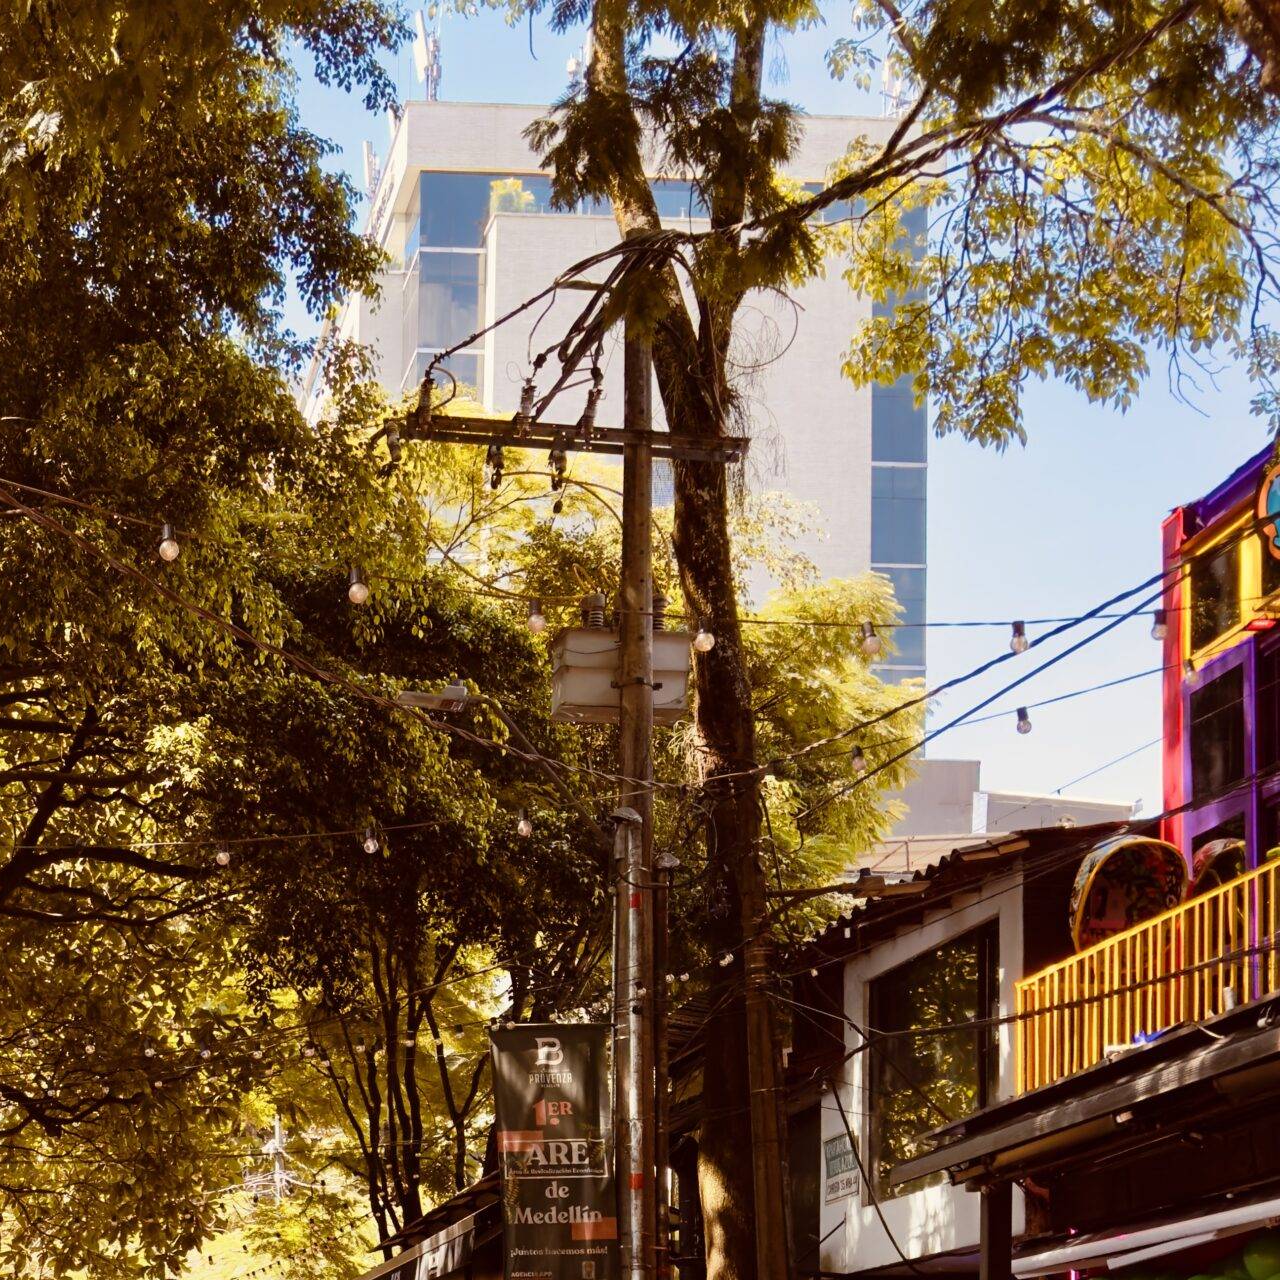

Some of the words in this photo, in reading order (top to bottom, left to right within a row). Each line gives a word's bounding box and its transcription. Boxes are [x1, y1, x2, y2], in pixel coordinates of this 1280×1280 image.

[528, 1072, 574, 1086] PROVENZA
[527, 1141, 591, 1166] ARE
[545, 1180, 570, 1198] de
[514, 1205, 603, 1225] Medellín
